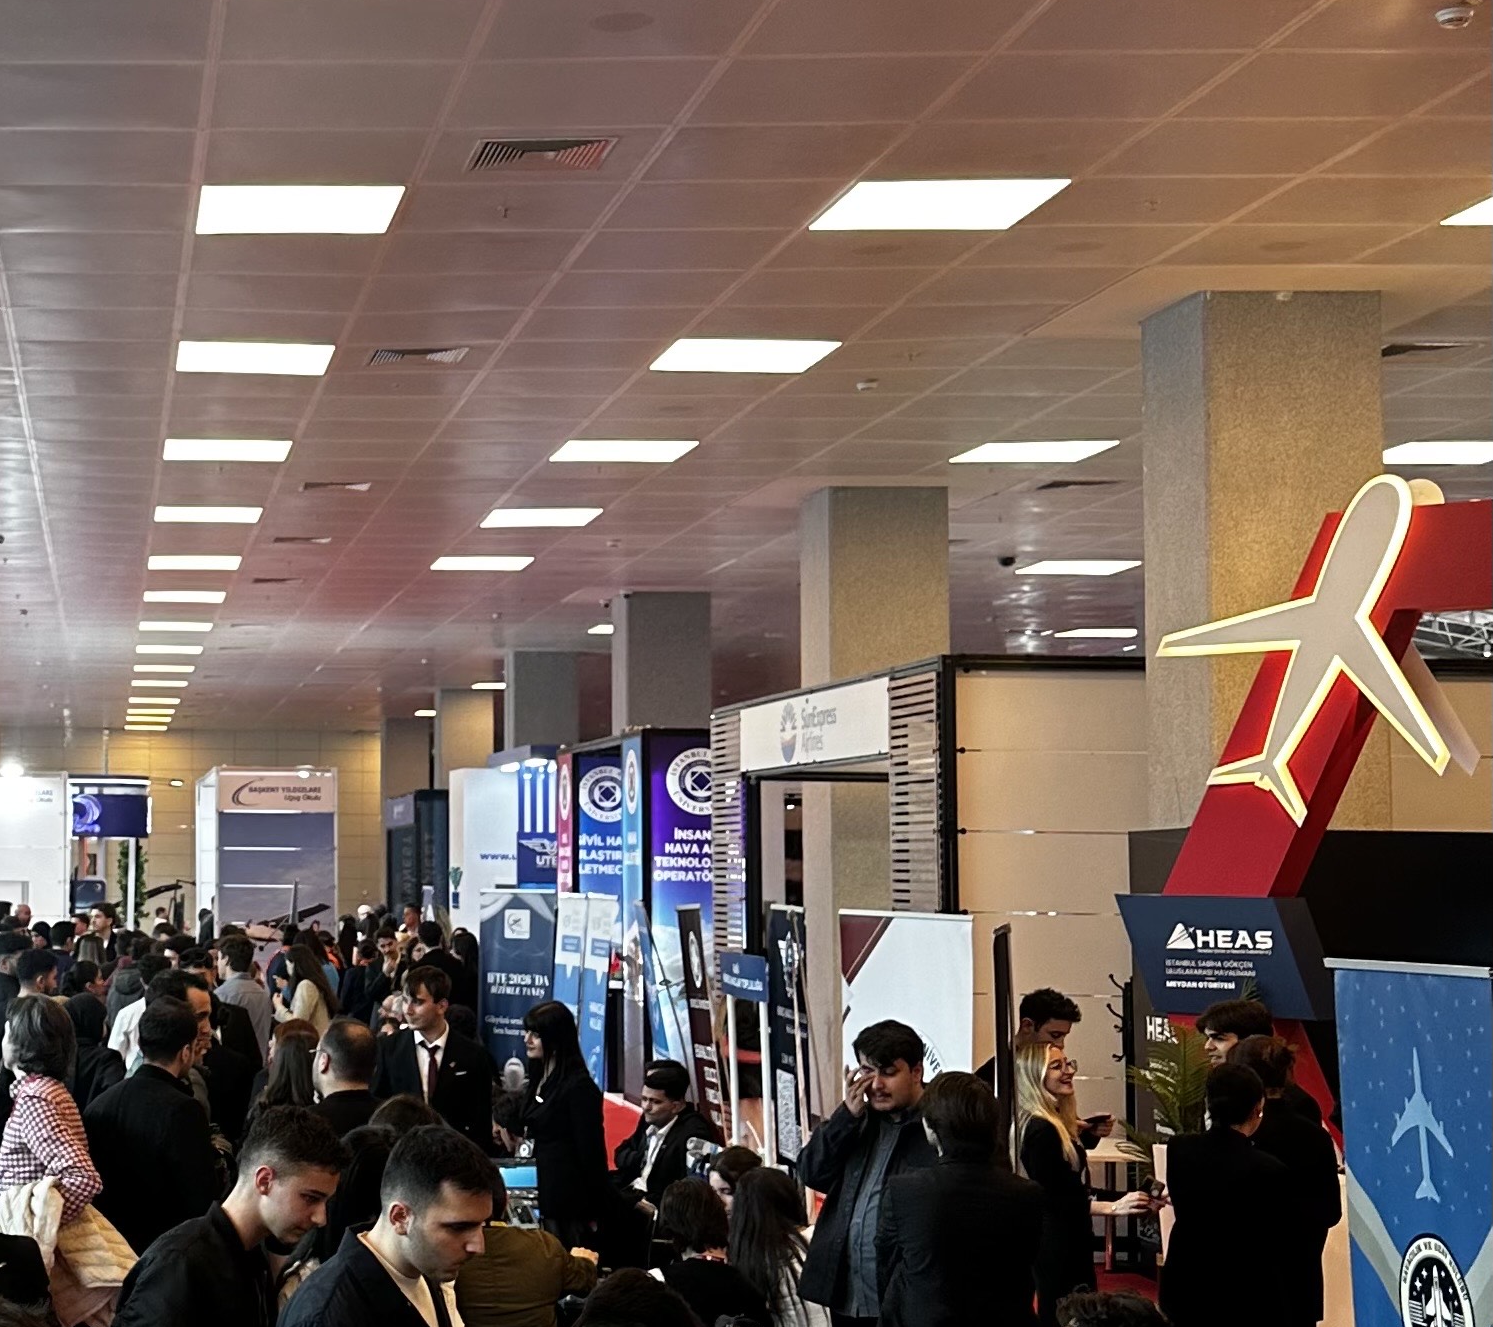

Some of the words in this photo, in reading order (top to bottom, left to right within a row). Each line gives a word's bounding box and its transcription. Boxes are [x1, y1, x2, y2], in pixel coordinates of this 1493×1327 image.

[664, 842, 700, 854] HAVA
[1195, 929, 1274, 950] HEAS
[1222, 959, 1254, 970] GÖKÇEN
[1165, 980, 1197, 989] MEYDAN
